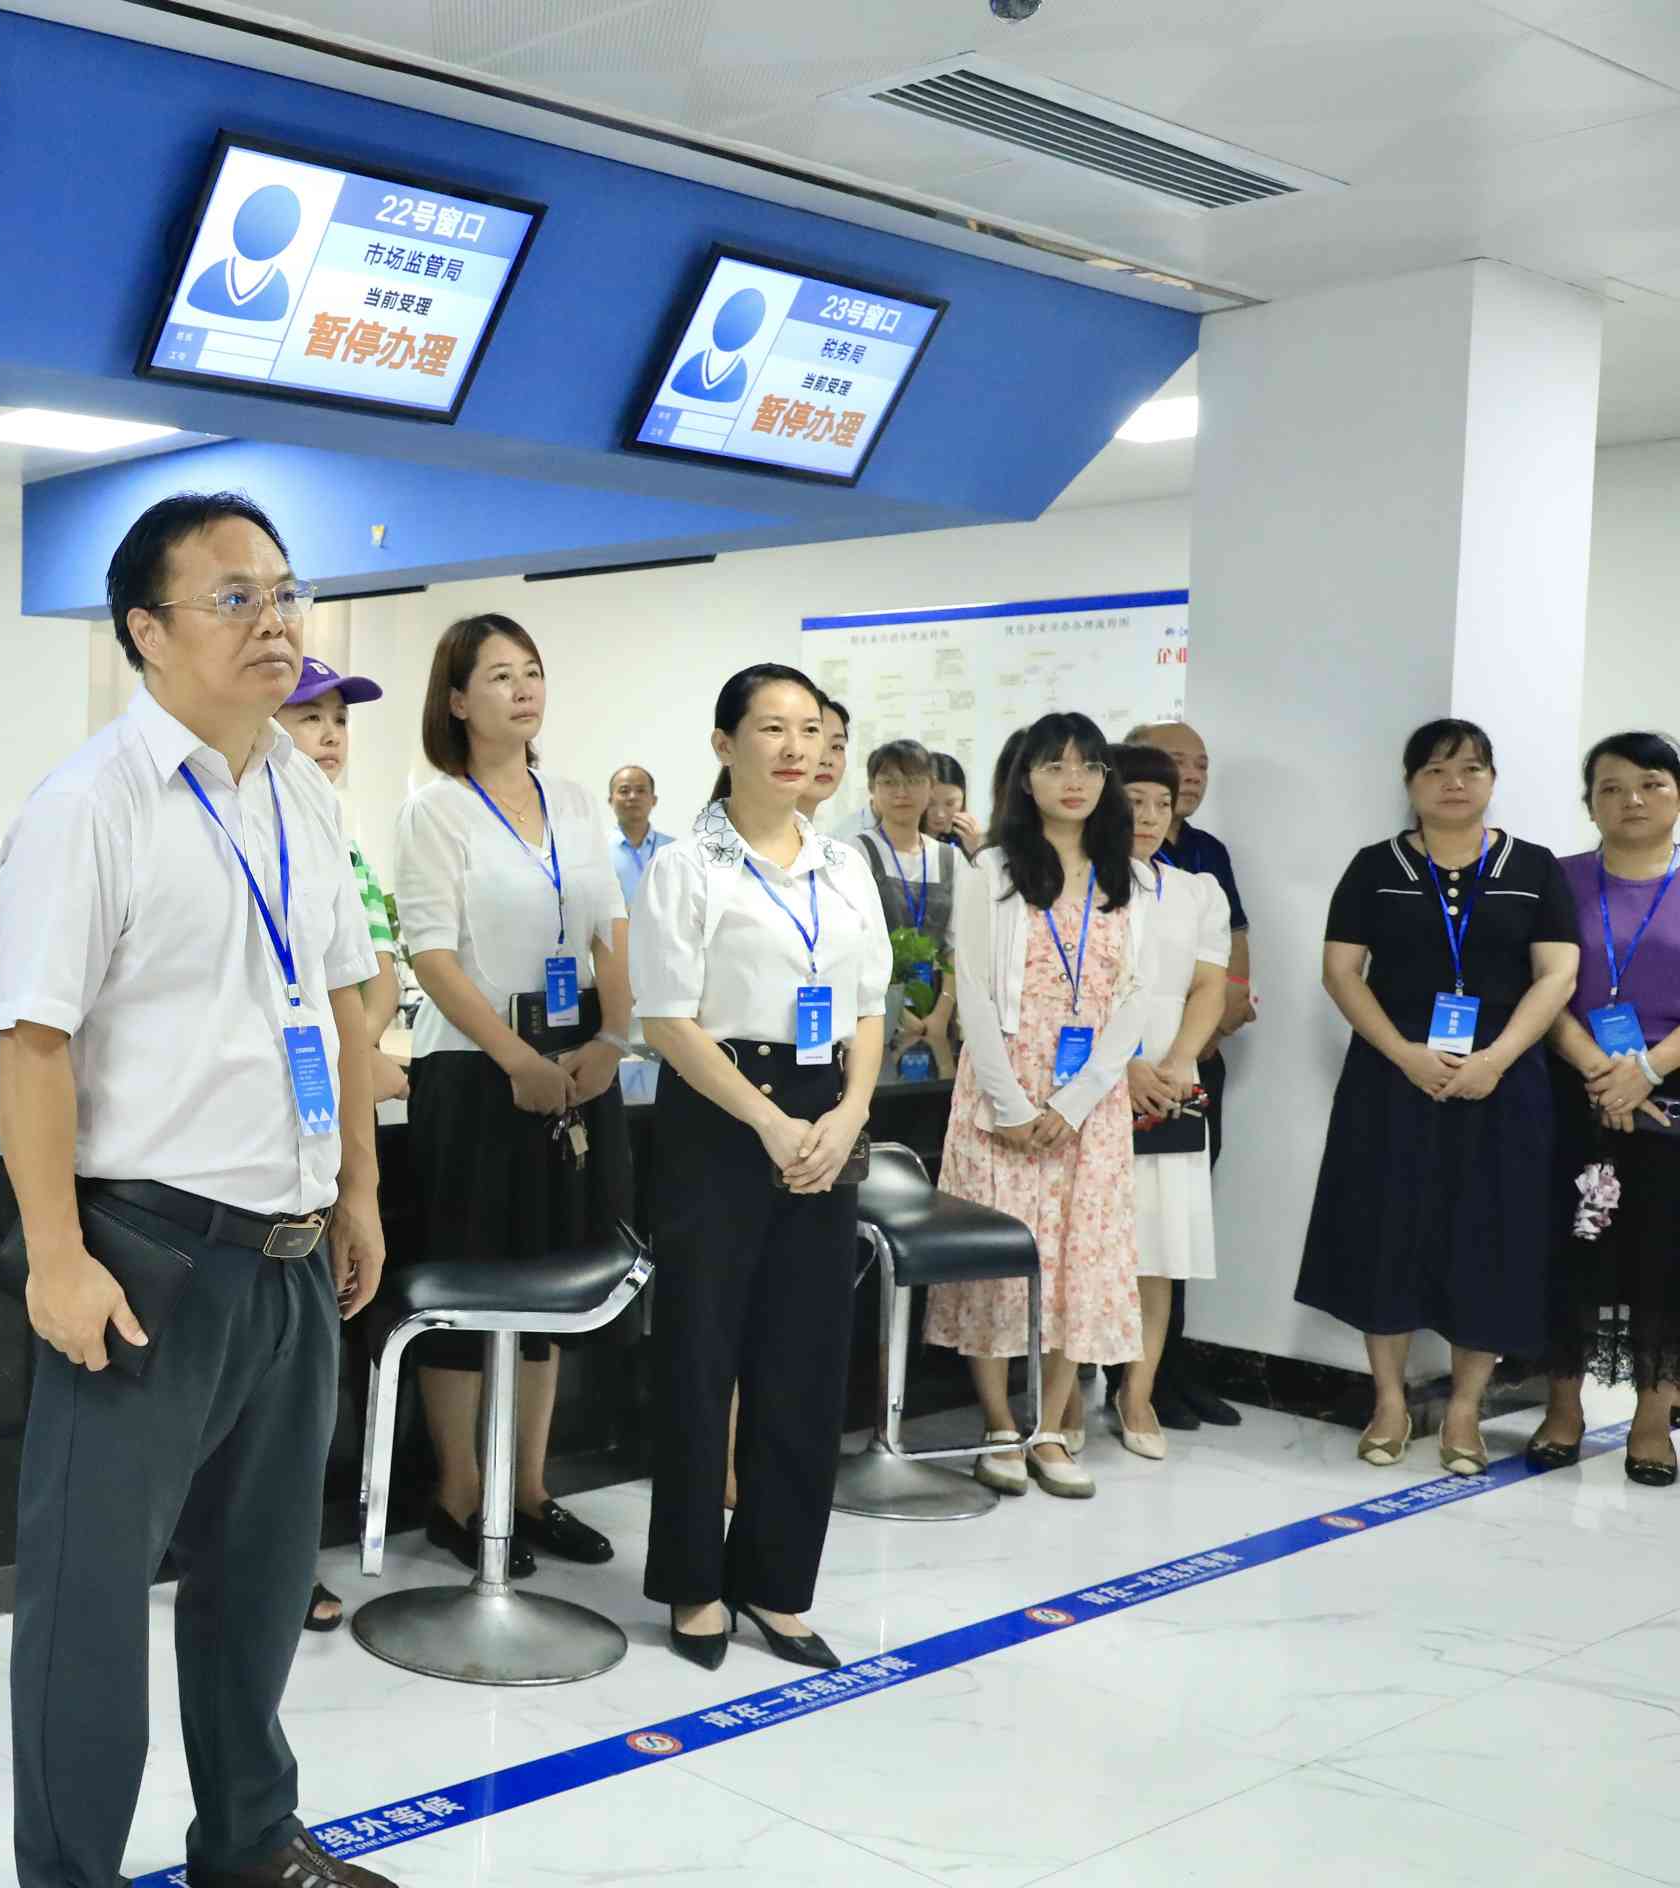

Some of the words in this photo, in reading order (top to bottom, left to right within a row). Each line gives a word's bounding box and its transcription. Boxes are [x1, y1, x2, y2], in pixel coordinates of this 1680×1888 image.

[375, 194, 486, 242] 22号窗口
[364, 242, 464, 282] 市场监管局
[364, 287, 433, 317] 当前受理
[819, 294, 902, 334] 23号窗口
[303, 311, 459, 377] 暂停办理
[751, 393, 867, 448] 暂停办理
[1077, 1551, 1245, 1606] 请在一米线外等候
[699, 1656, 917, 1728] 请在一米线外等候
